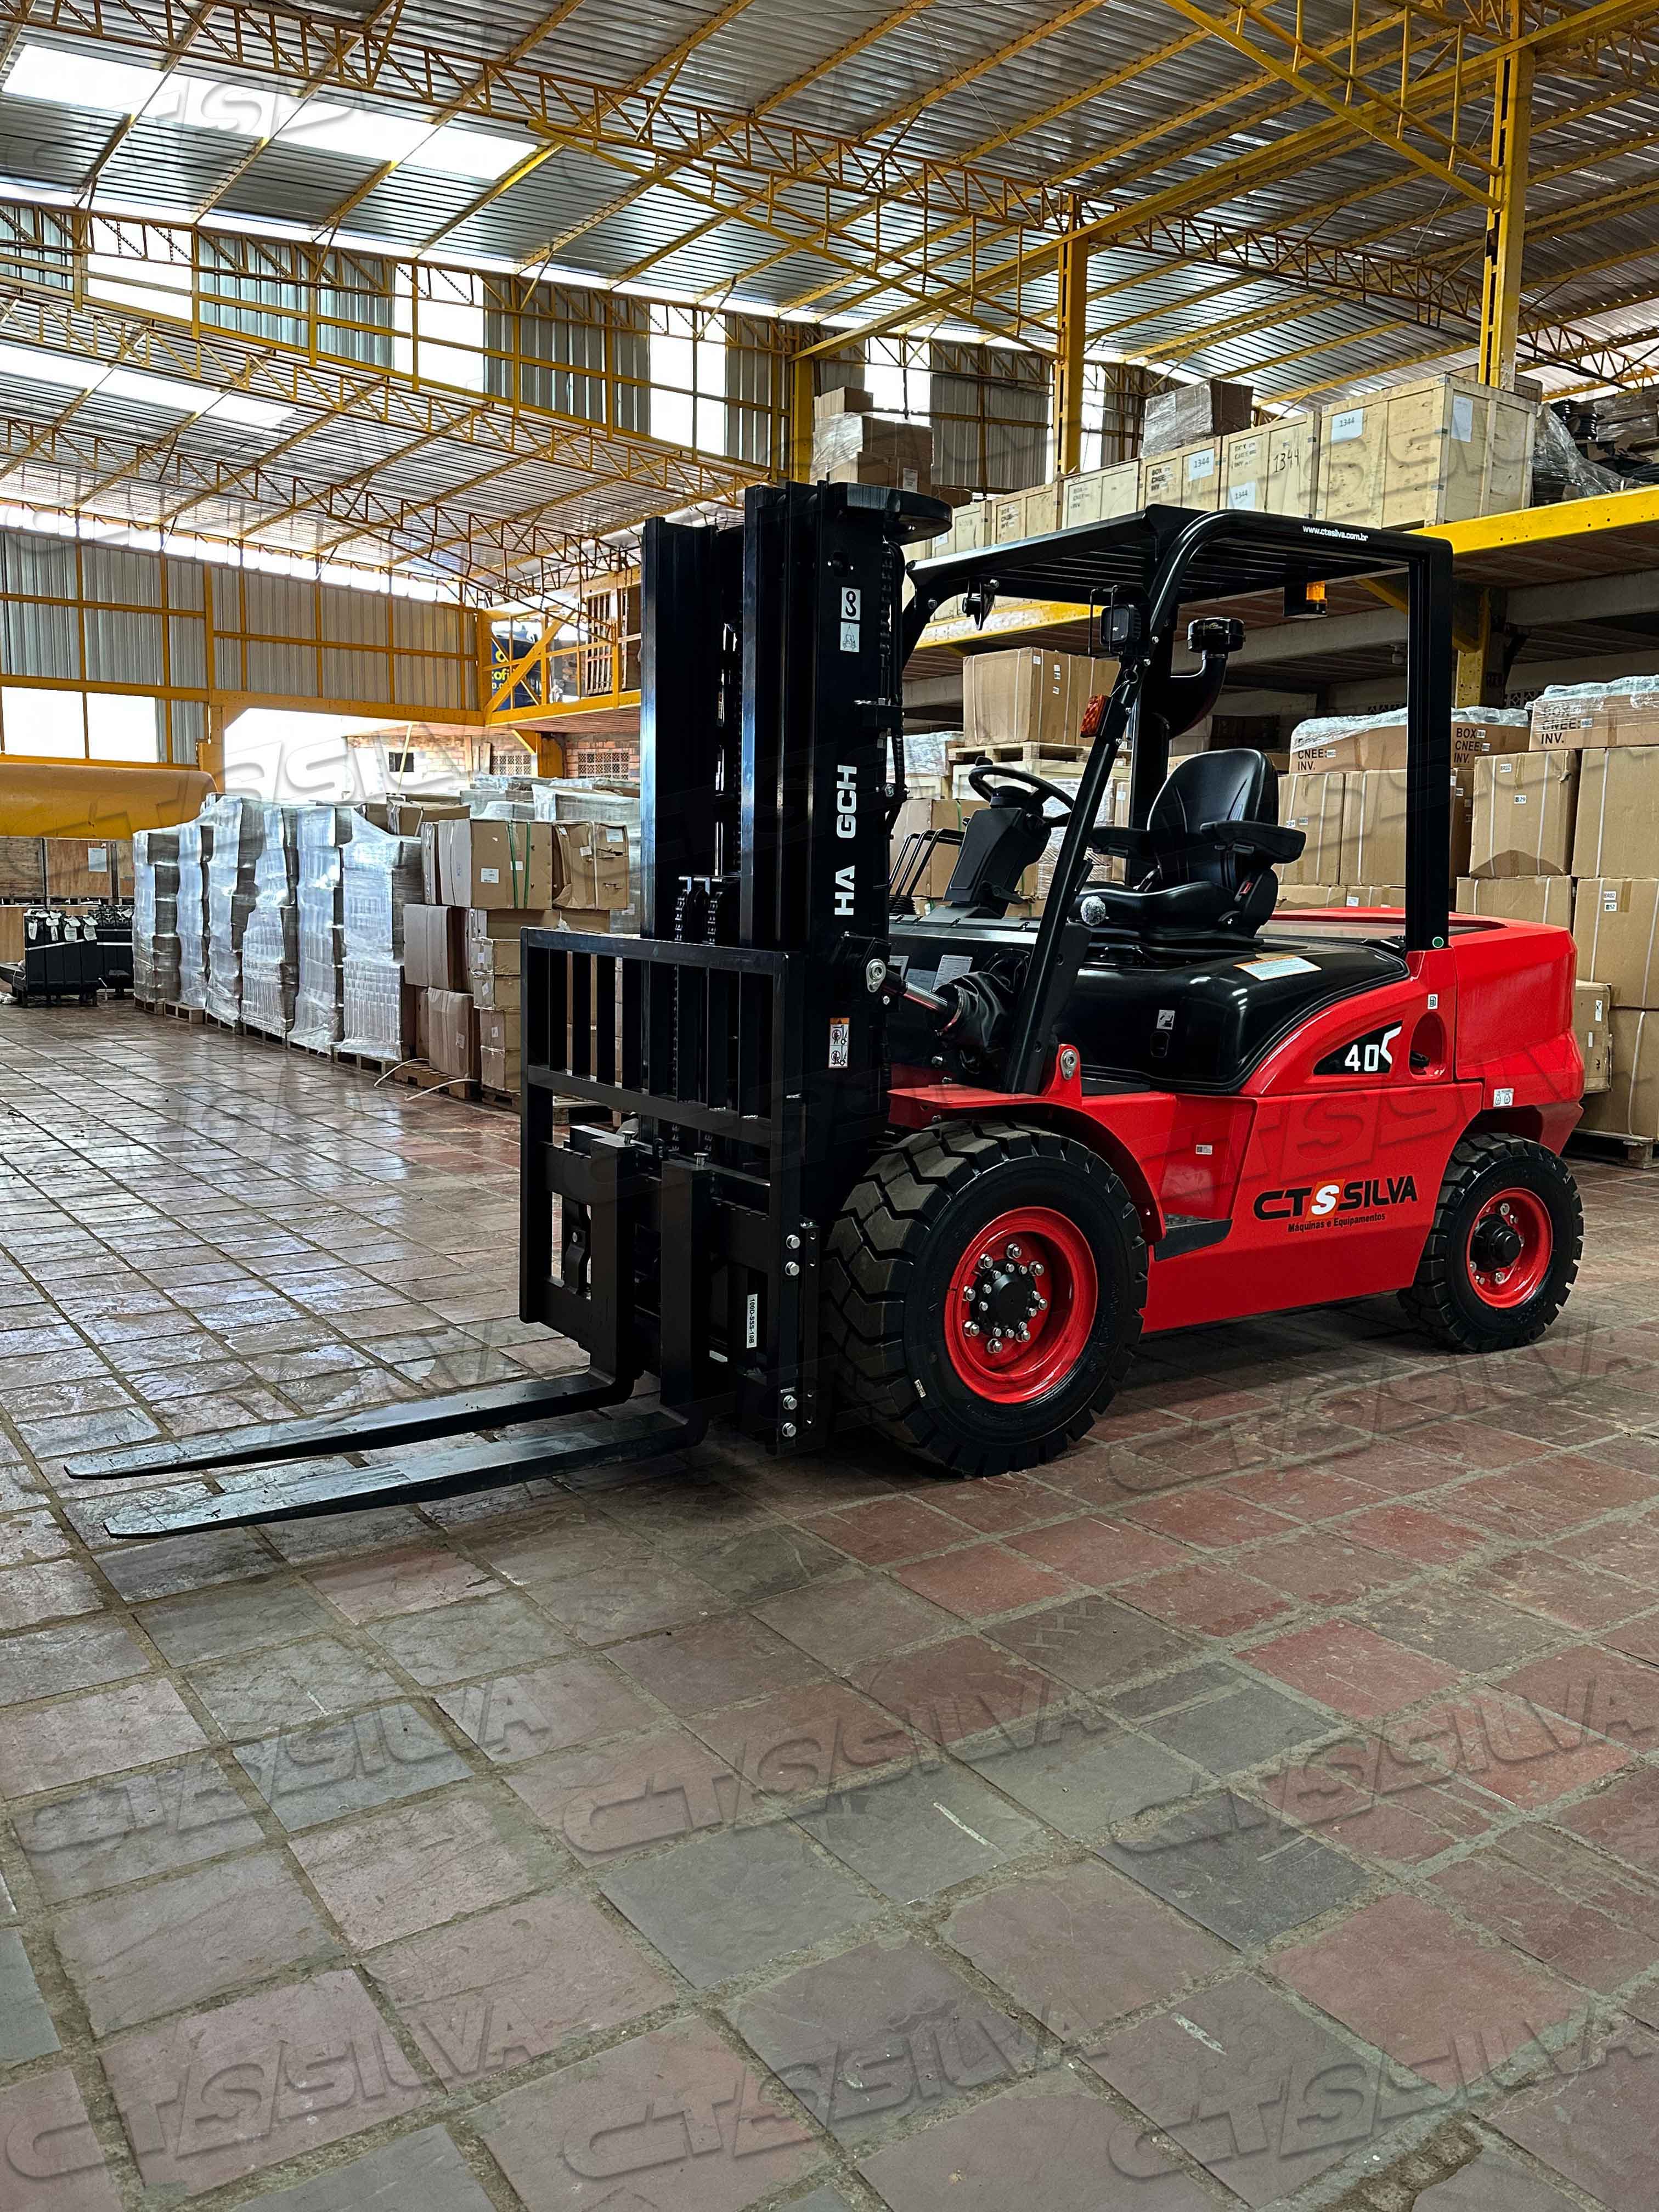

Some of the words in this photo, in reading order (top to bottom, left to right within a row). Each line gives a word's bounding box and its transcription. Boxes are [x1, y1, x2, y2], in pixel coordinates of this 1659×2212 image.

[1339, 417, 1355, 427] 1344
[1194, 456, 1210, 469] 1344
[1273, 448, 1299, 473] 1344
[1234, 489, 1249, 499] 1344
[1456, 727, 1477, 738] BOX
[1541, 732, 1564, 744] INV.
[1453, 753, 1470, 763] INV.
[1297, 761, 1316, 771] INV.
[1288, 1220, 1325, 1233] Máquinas
[1333, 1214, 1386, 1227] Equipamentos
